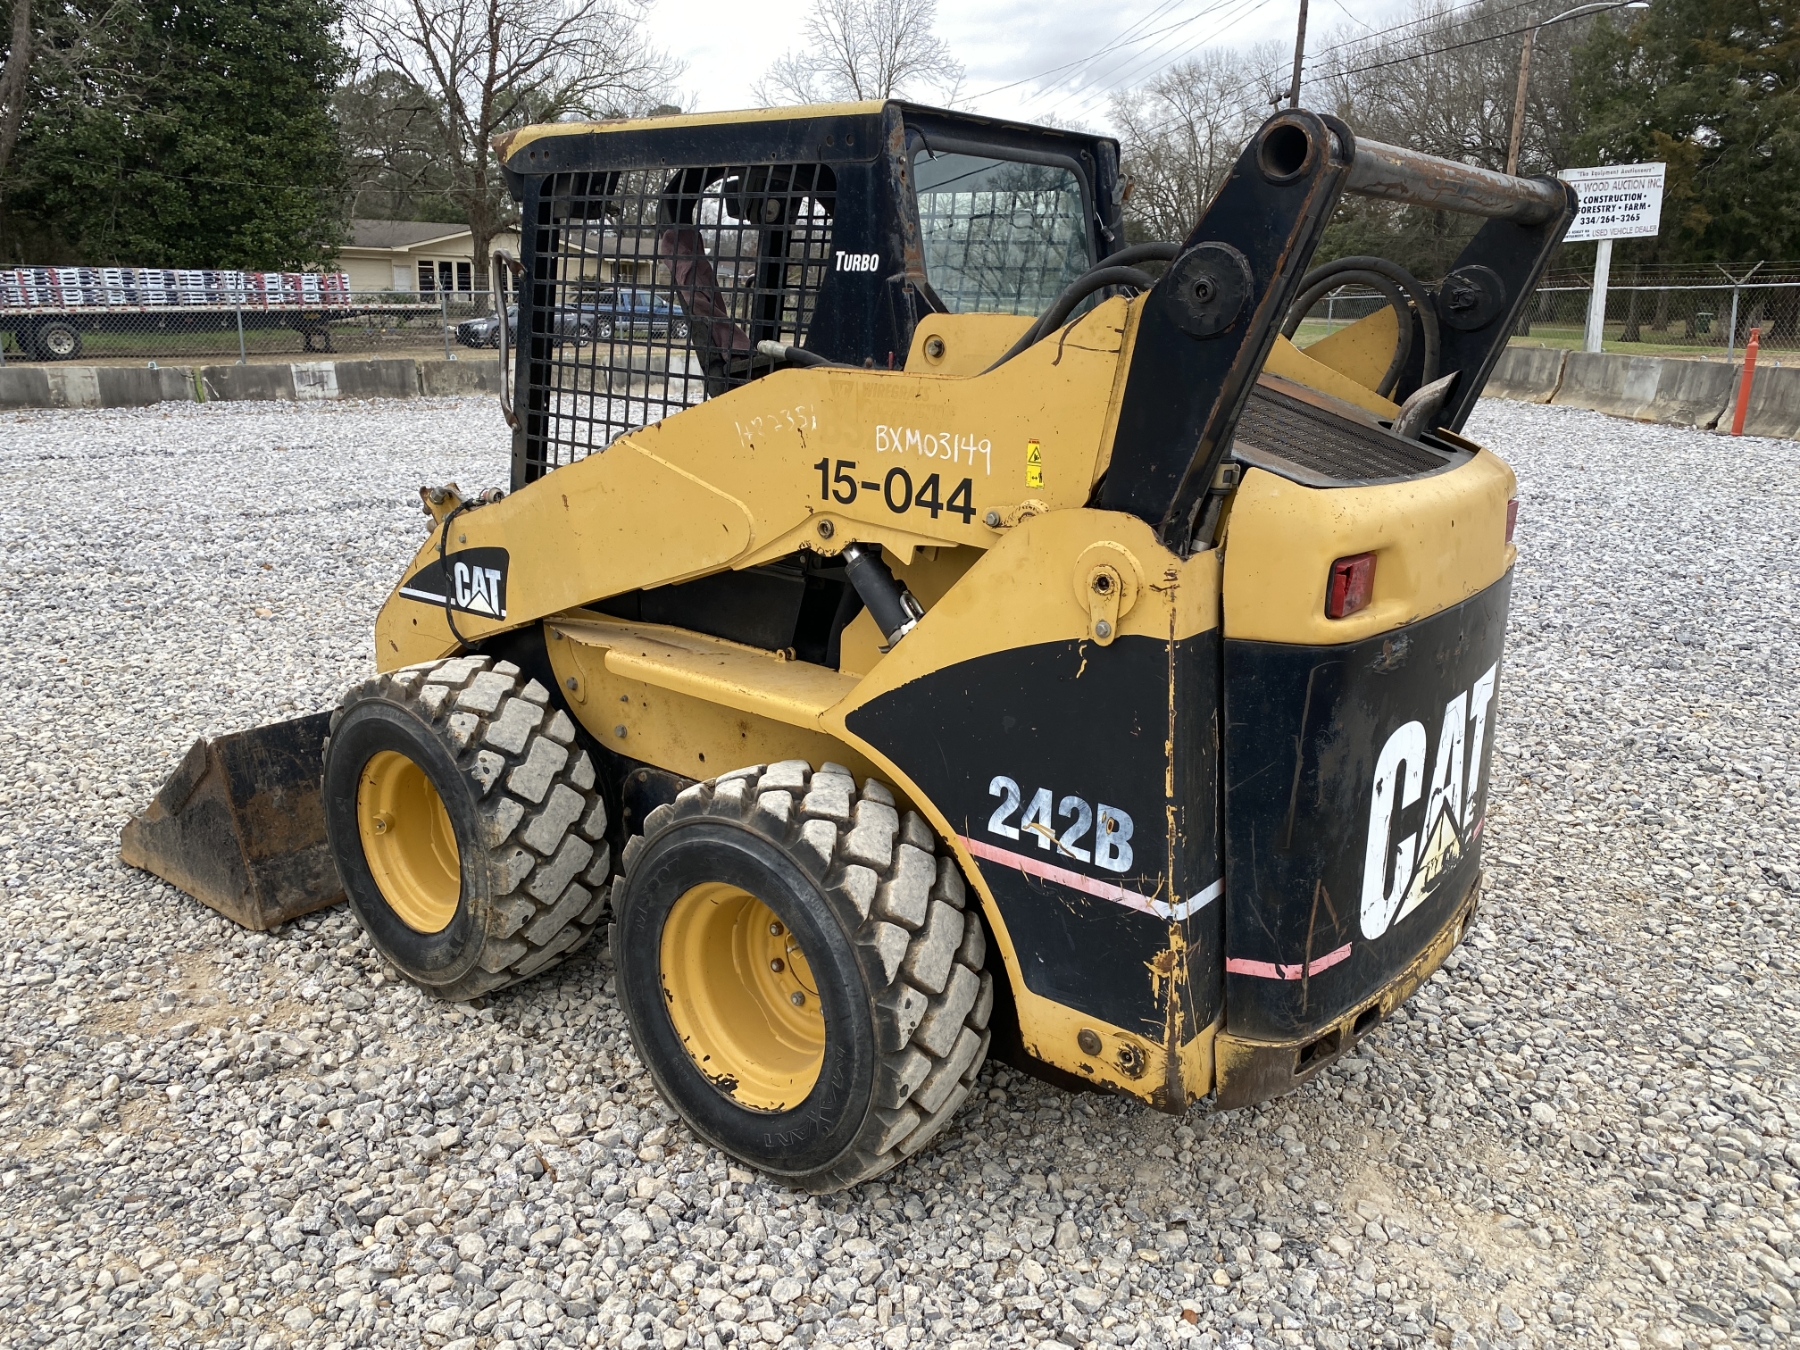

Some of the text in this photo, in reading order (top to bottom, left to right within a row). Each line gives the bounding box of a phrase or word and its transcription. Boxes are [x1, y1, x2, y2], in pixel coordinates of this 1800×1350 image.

[1591, 169, 1618, 177] Equipment
[1584, 181, 1610, 193] WOOD
[1612, 179, 1645, 191] AUCTION
[1647, 178, 1662, 189] INC.
[1583, 192, 1643, 205] CONSTRUCTION
[1624, 202, 1647, 212] FARM
[1580, 213, 1641, 225] 334/264-3265
[1592, 228, 1608, 238] USED
[1609, 226, 1633, 236] VEHICLE
[1635, 224, 1657, 234] DEALER
[875, 424, 992, 475] BXM03149
[813, 457, 977, 525] 15-044
[454, 561, 502, 616] CAT
[1360, 657, 1500, 941] CAT
[987, 775, 1134, 873] 242B
